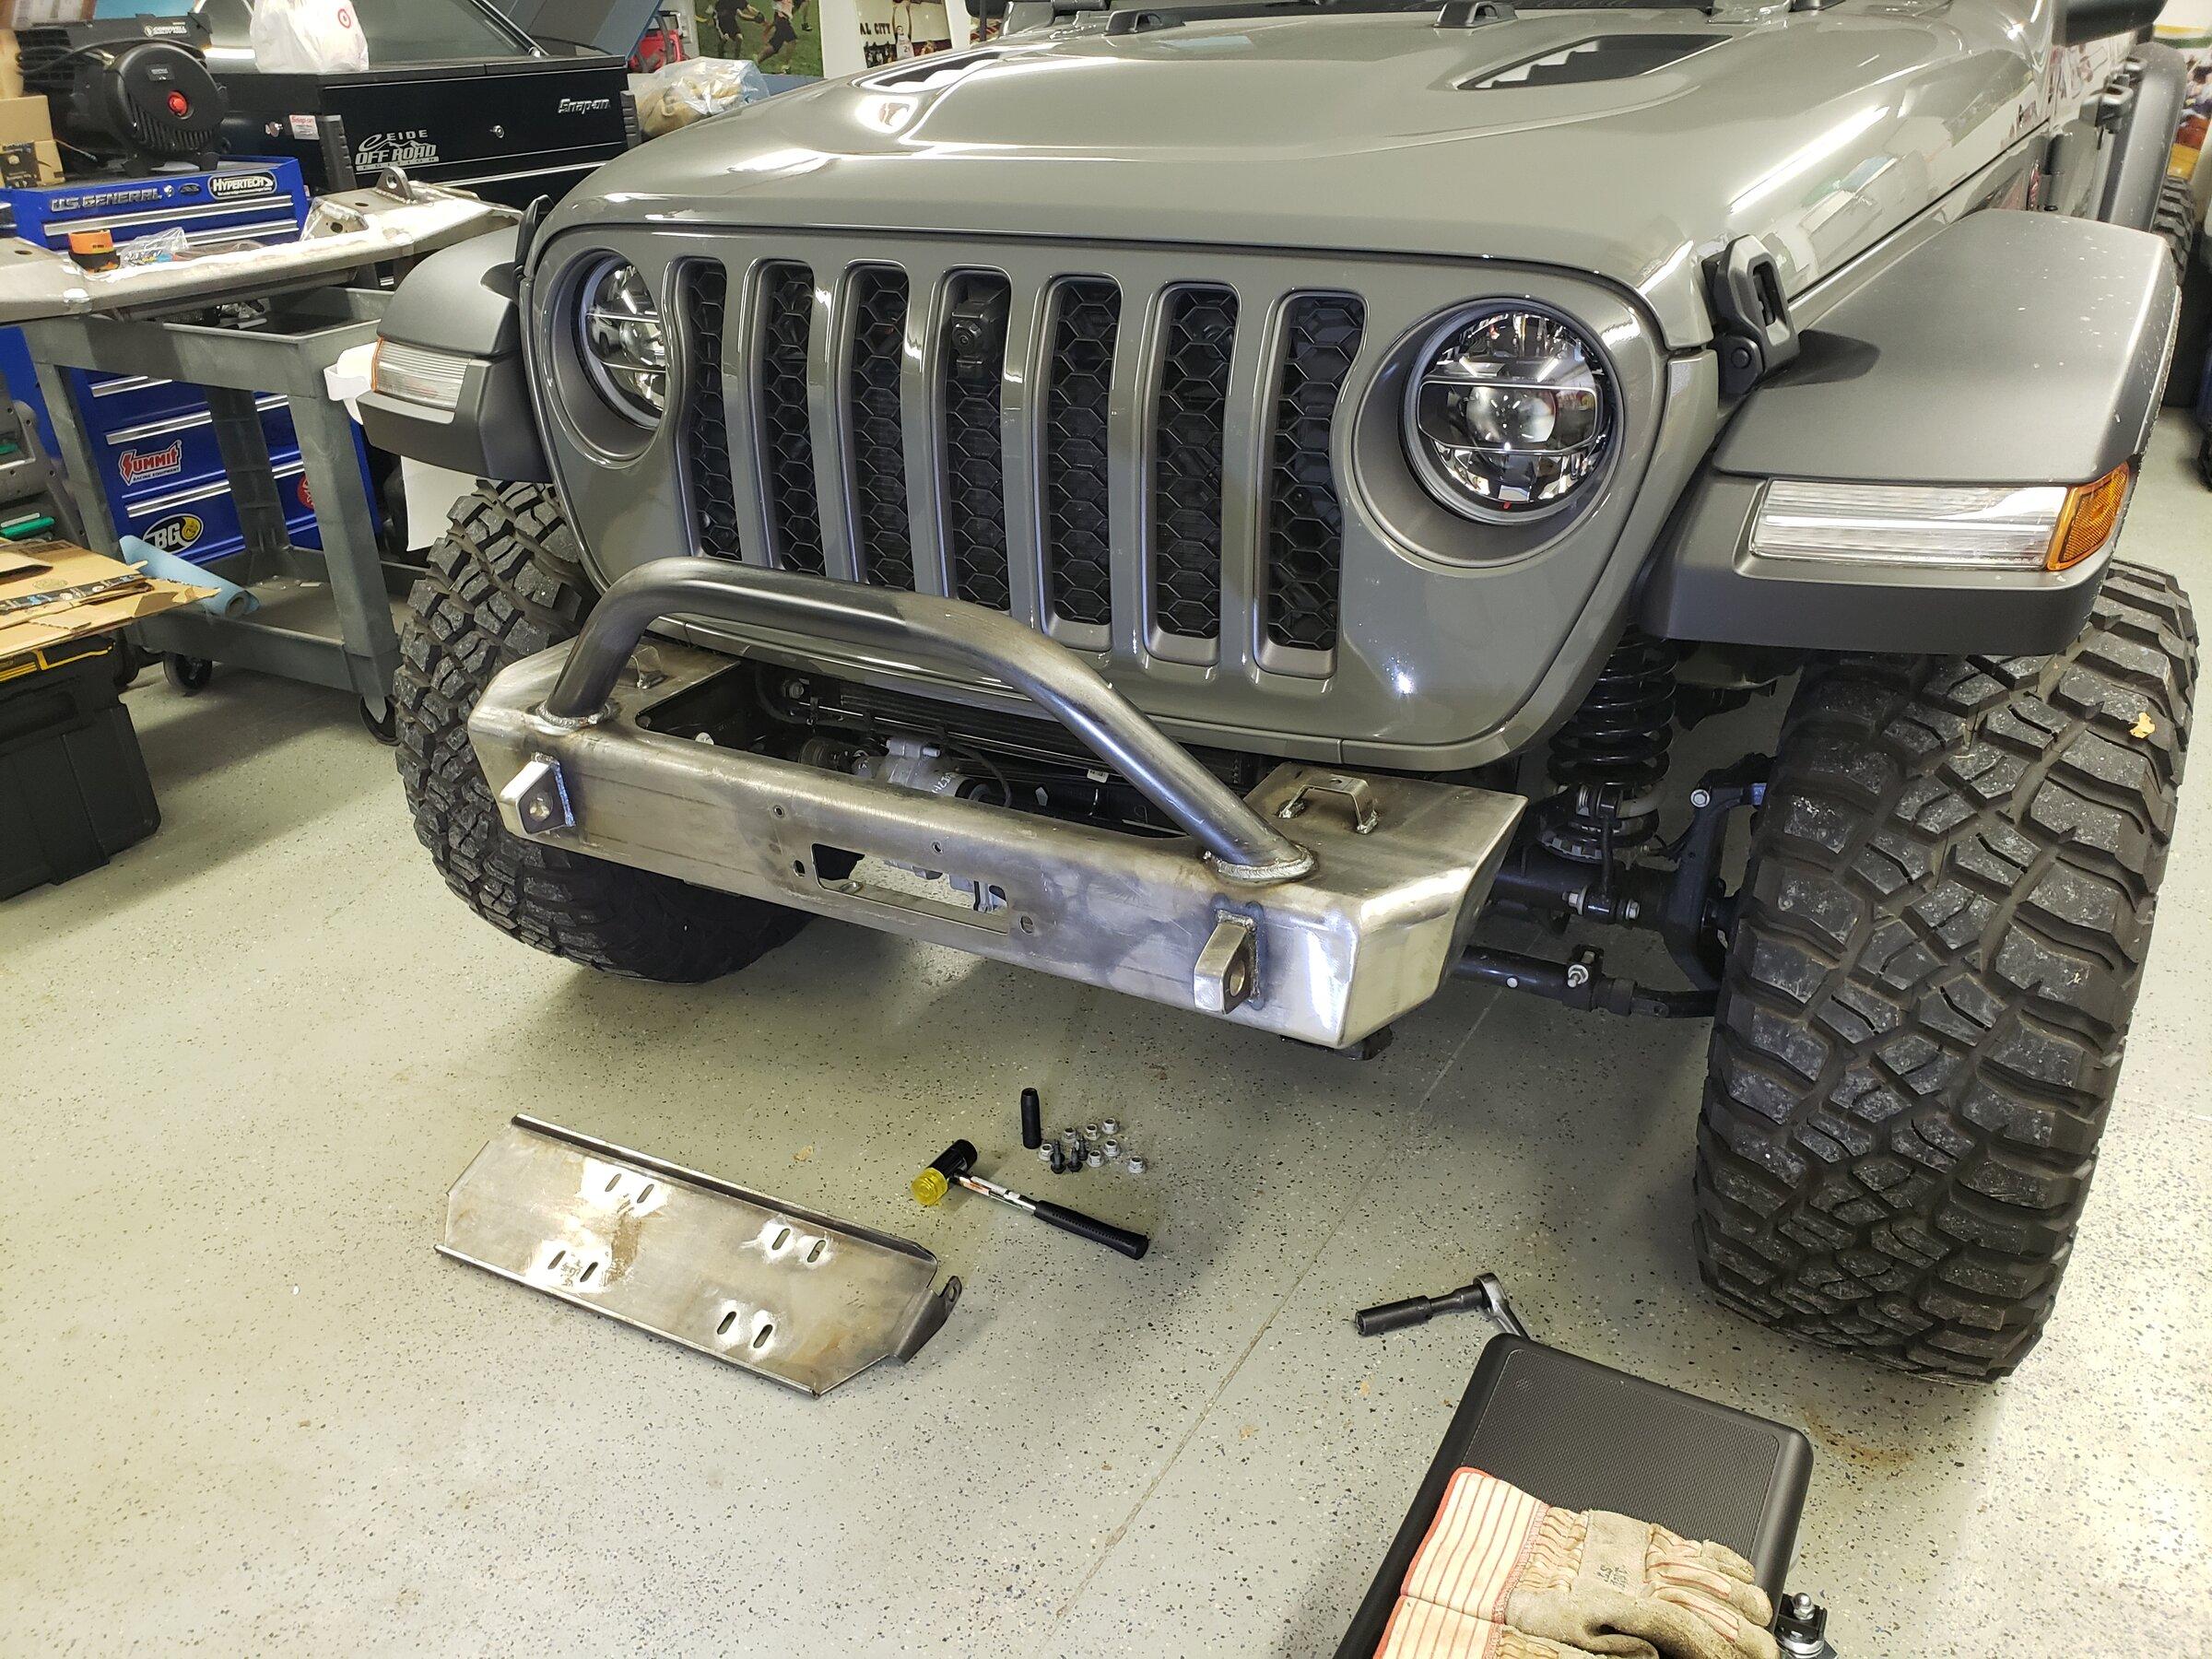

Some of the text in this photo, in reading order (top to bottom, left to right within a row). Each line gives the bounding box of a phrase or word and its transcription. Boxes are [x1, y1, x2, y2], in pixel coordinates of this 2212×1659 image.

[874, 23, 890, 34] CITY
[558, 98, 611, 114] Snap-on
[355, 150, 390, 165] OFF
[392, 145, 436, 161] ROAD
[213, 176, 265, 192] HYPERTECH
[82, 188, 161, 208] GENERAL
[154, 523, 181, 549] BG
